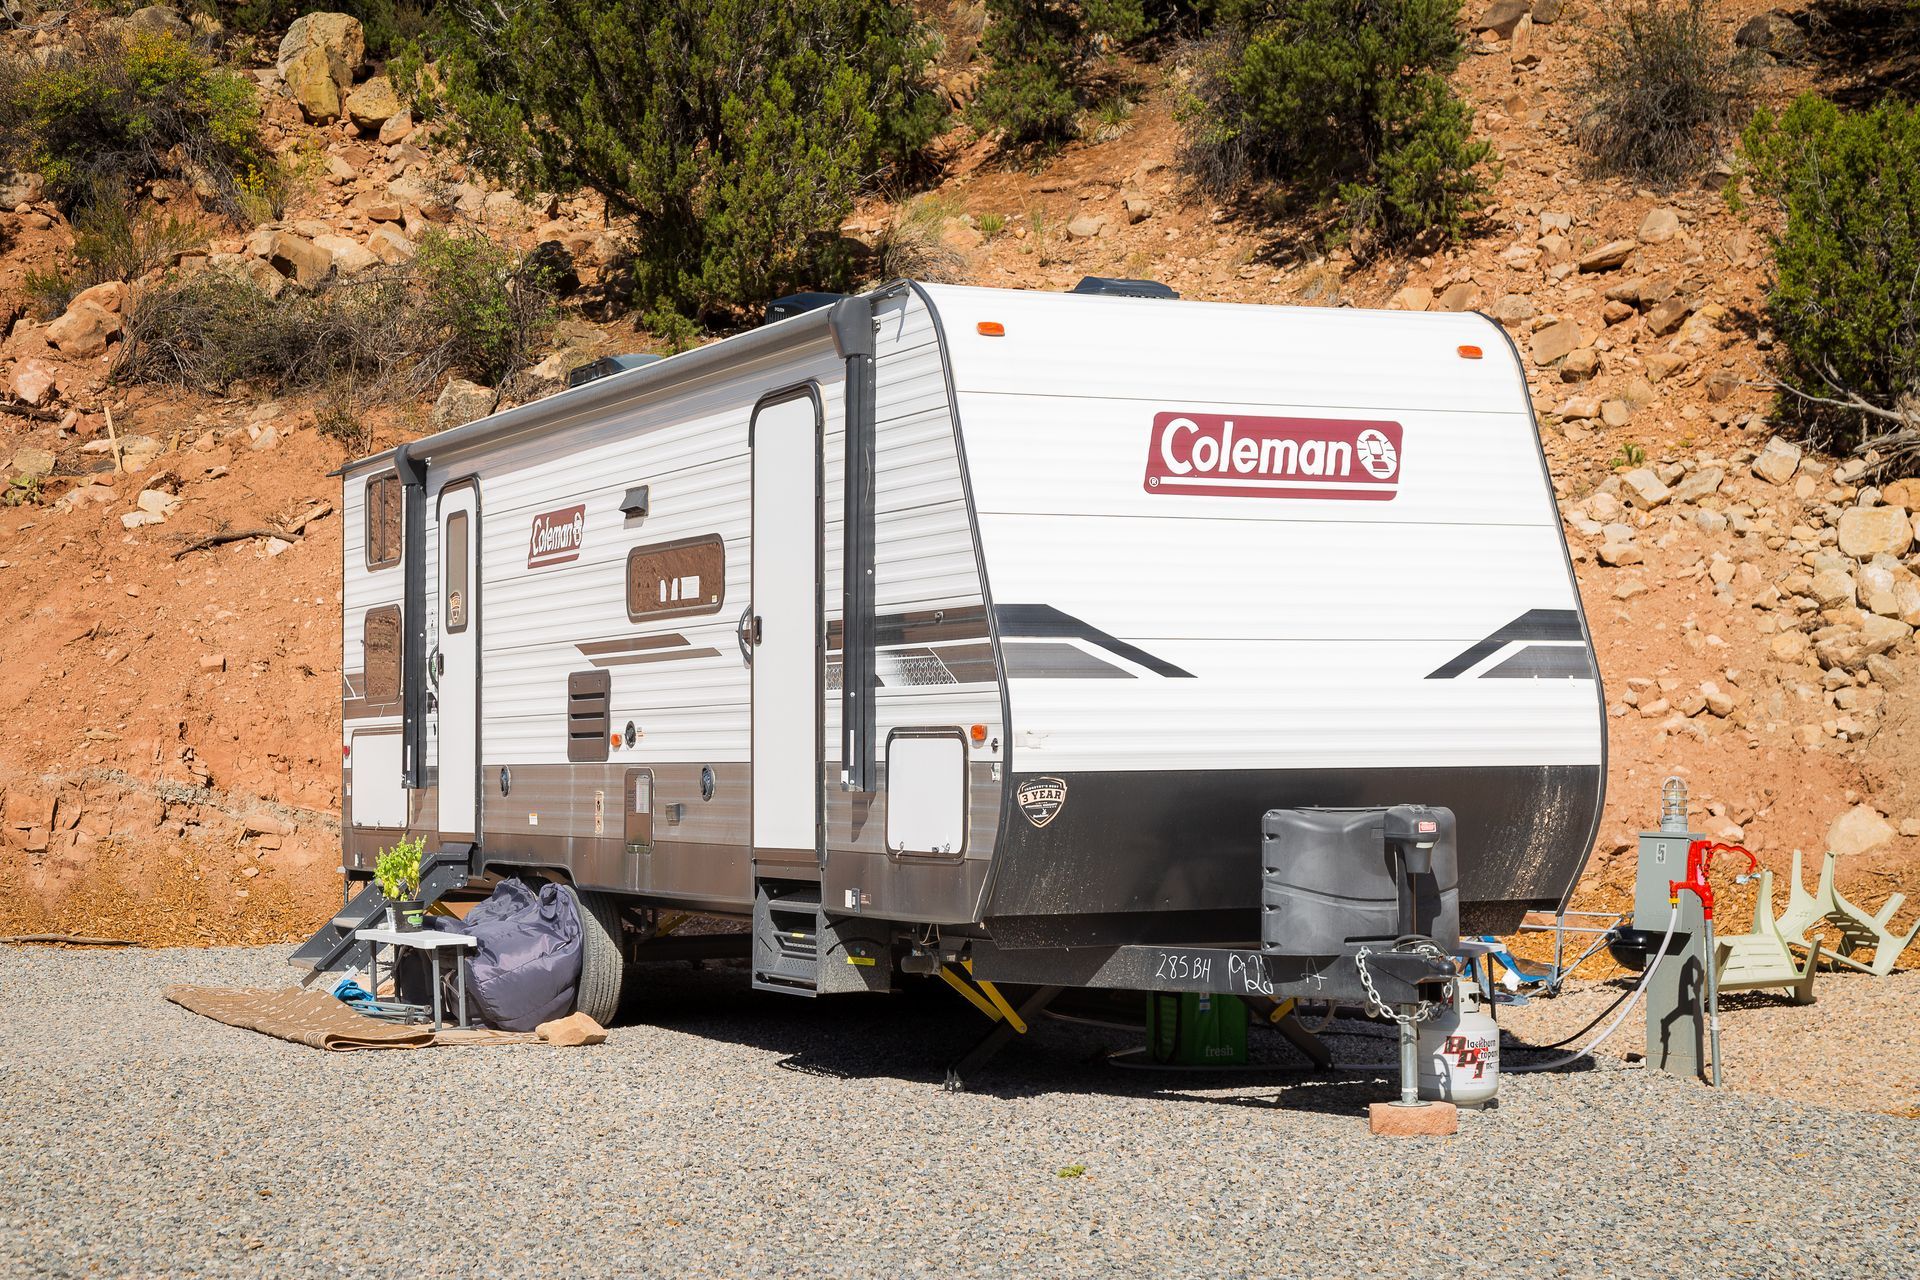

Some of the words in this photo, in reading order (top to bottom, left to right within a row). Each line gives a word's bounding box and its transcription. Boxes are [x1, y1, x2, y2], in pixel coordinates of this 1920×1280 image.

[1161, 418, 1352, 477] Coleman
[533, 517, 573, 556] Coleman
[1021, 794, 1029, 803] 3
[1031, 790, 1062, 800] YEAR
[1205, 1045, 1233, 1057] fresh
